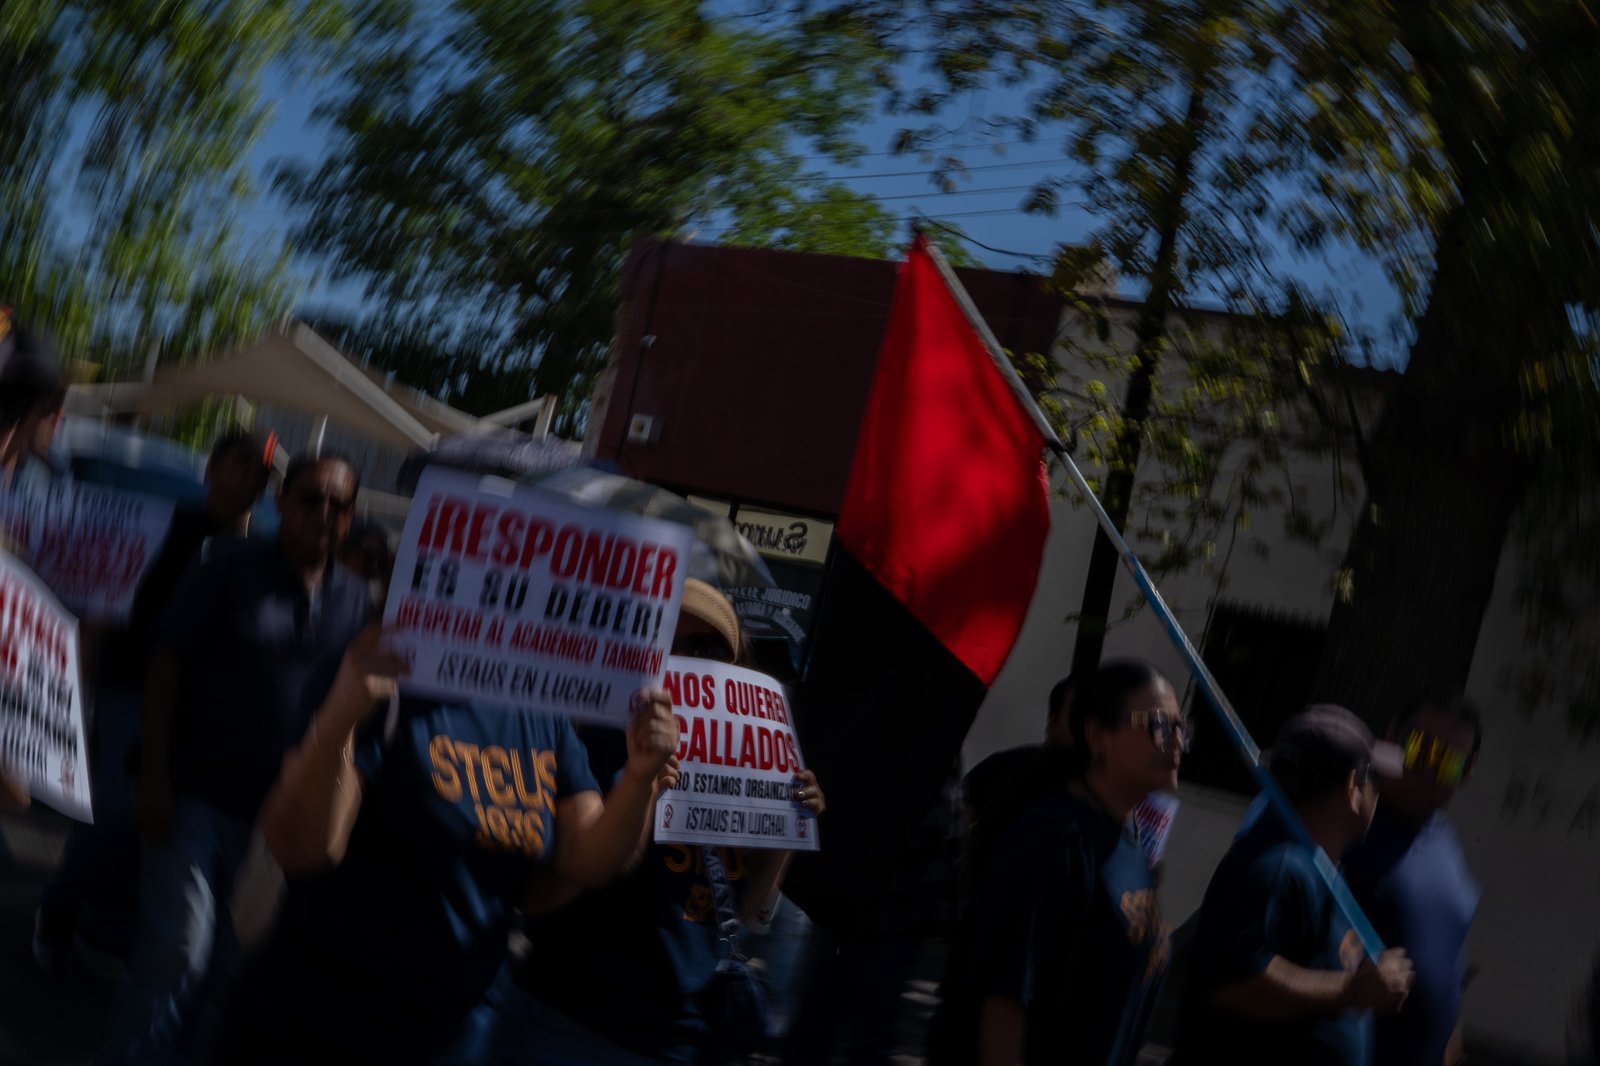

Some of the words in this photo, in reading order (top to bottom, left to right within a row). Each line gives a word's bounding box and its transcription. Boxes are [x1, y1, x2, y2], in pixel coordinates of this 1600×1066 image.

[411, 556, 459, 600] ES
[480, 569, 530, 613] SU
[544, 583, 665, 640] DEBER!
[485, 617, 505, 644] AL
[510, 667, 538, 698] EN
[540, 673, 611, 707] LUCHA!
[663, 671, 716, 710] NOS
[675, 714, 800, 773] CALLADOS
[693, 773, 741, 797] ESTAMOS
[686, 806, 726, 832] ¡STAUS
[730, 811, 744, 834] EN
[748, 813, 787, 837] LUCHA!
